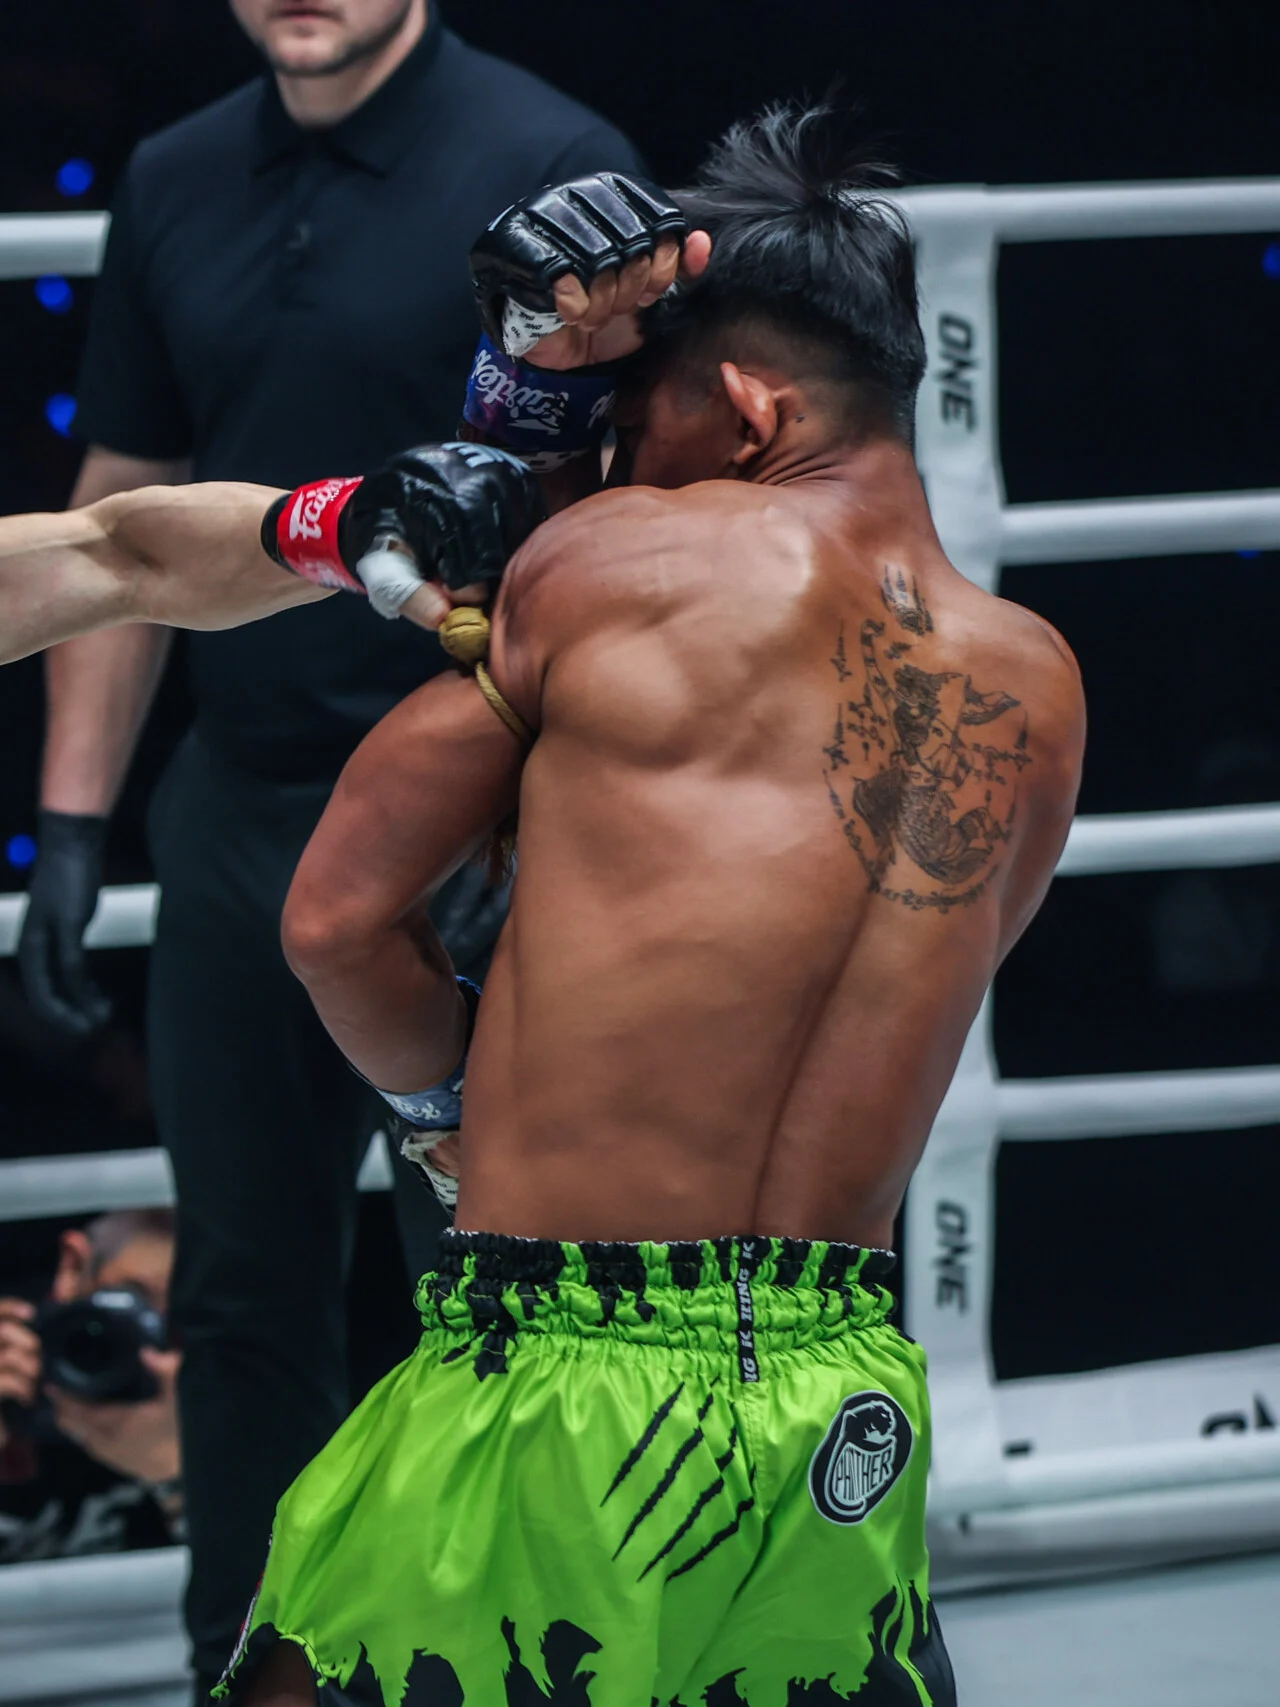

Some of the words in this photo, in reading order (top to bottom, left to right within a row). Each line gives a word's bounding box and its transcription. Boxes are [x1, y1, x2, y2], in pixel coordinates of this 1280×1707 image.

[935, 312, 977, 433] ONE
[933, 1200, 972, 1315] ONE
[834, 1446, 892, 1501] PANTHER
